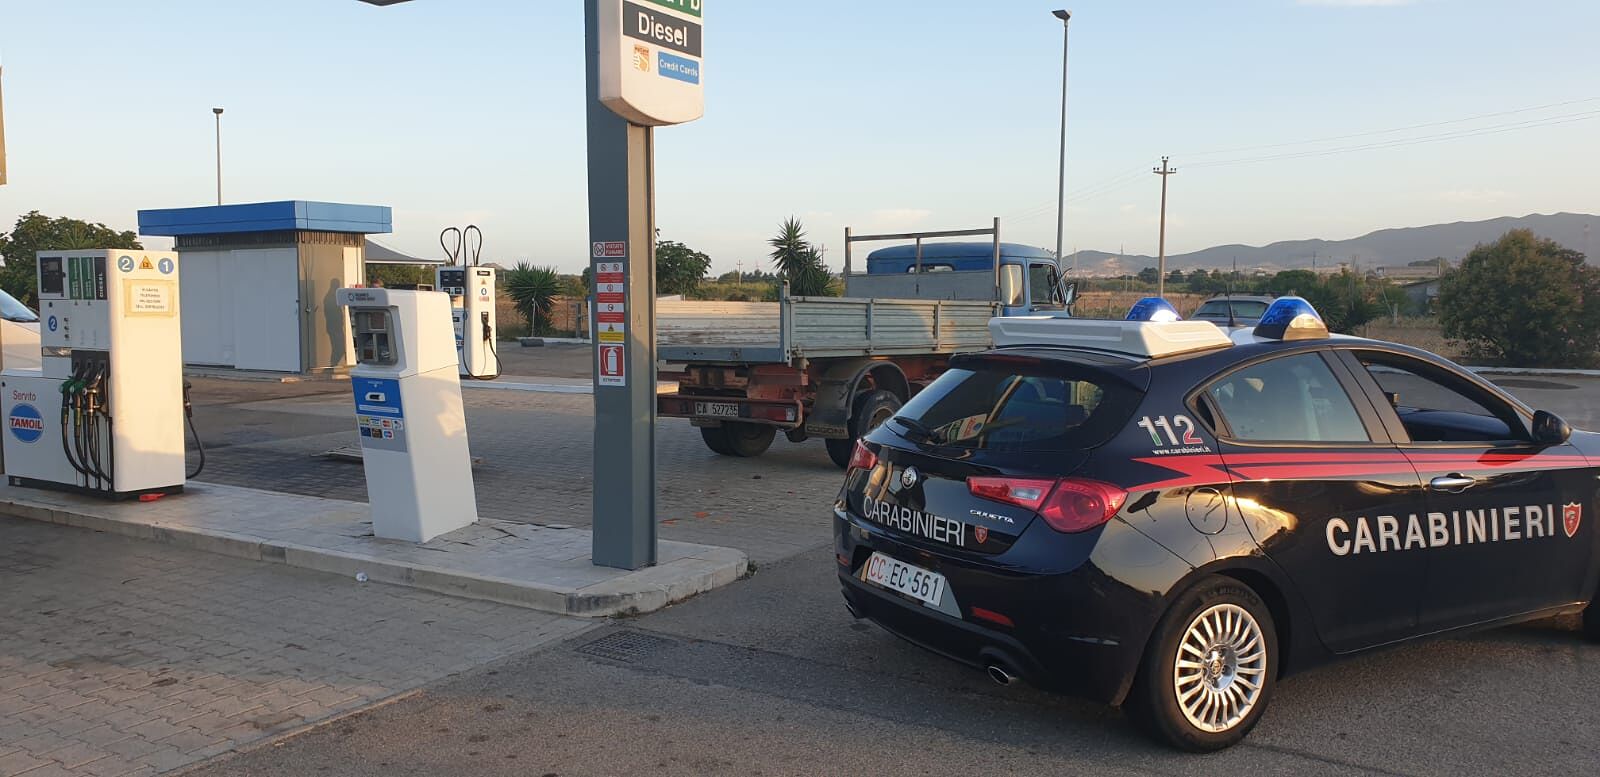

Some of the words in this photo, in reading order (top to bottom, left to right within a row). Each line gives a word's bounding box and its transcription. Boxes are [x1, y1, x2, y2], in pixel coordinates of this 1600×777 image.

[638, 11, 688, 47] Diesel
[659, 59, 679, 73] Credit
[679, 64, 698, 77] Cards
[121, 258, 131, 270] 2
[162, 260, 169, 272] 1
[13, 390, 37, 401] Servito
[10, 417, 43, 429] TAMOIL
[1137, 414, 1204, 447] 112
[1152, 445, 1212, 455] www.carabinieri.it
[863, 495, 966, 547] CARABINIERI
[1325, 503, 1555, 556] CARABINIERI
[870, 556, 887, 580] CC
[889, 563, 909, 589] EC
[911, 571, 940, 601] 561
